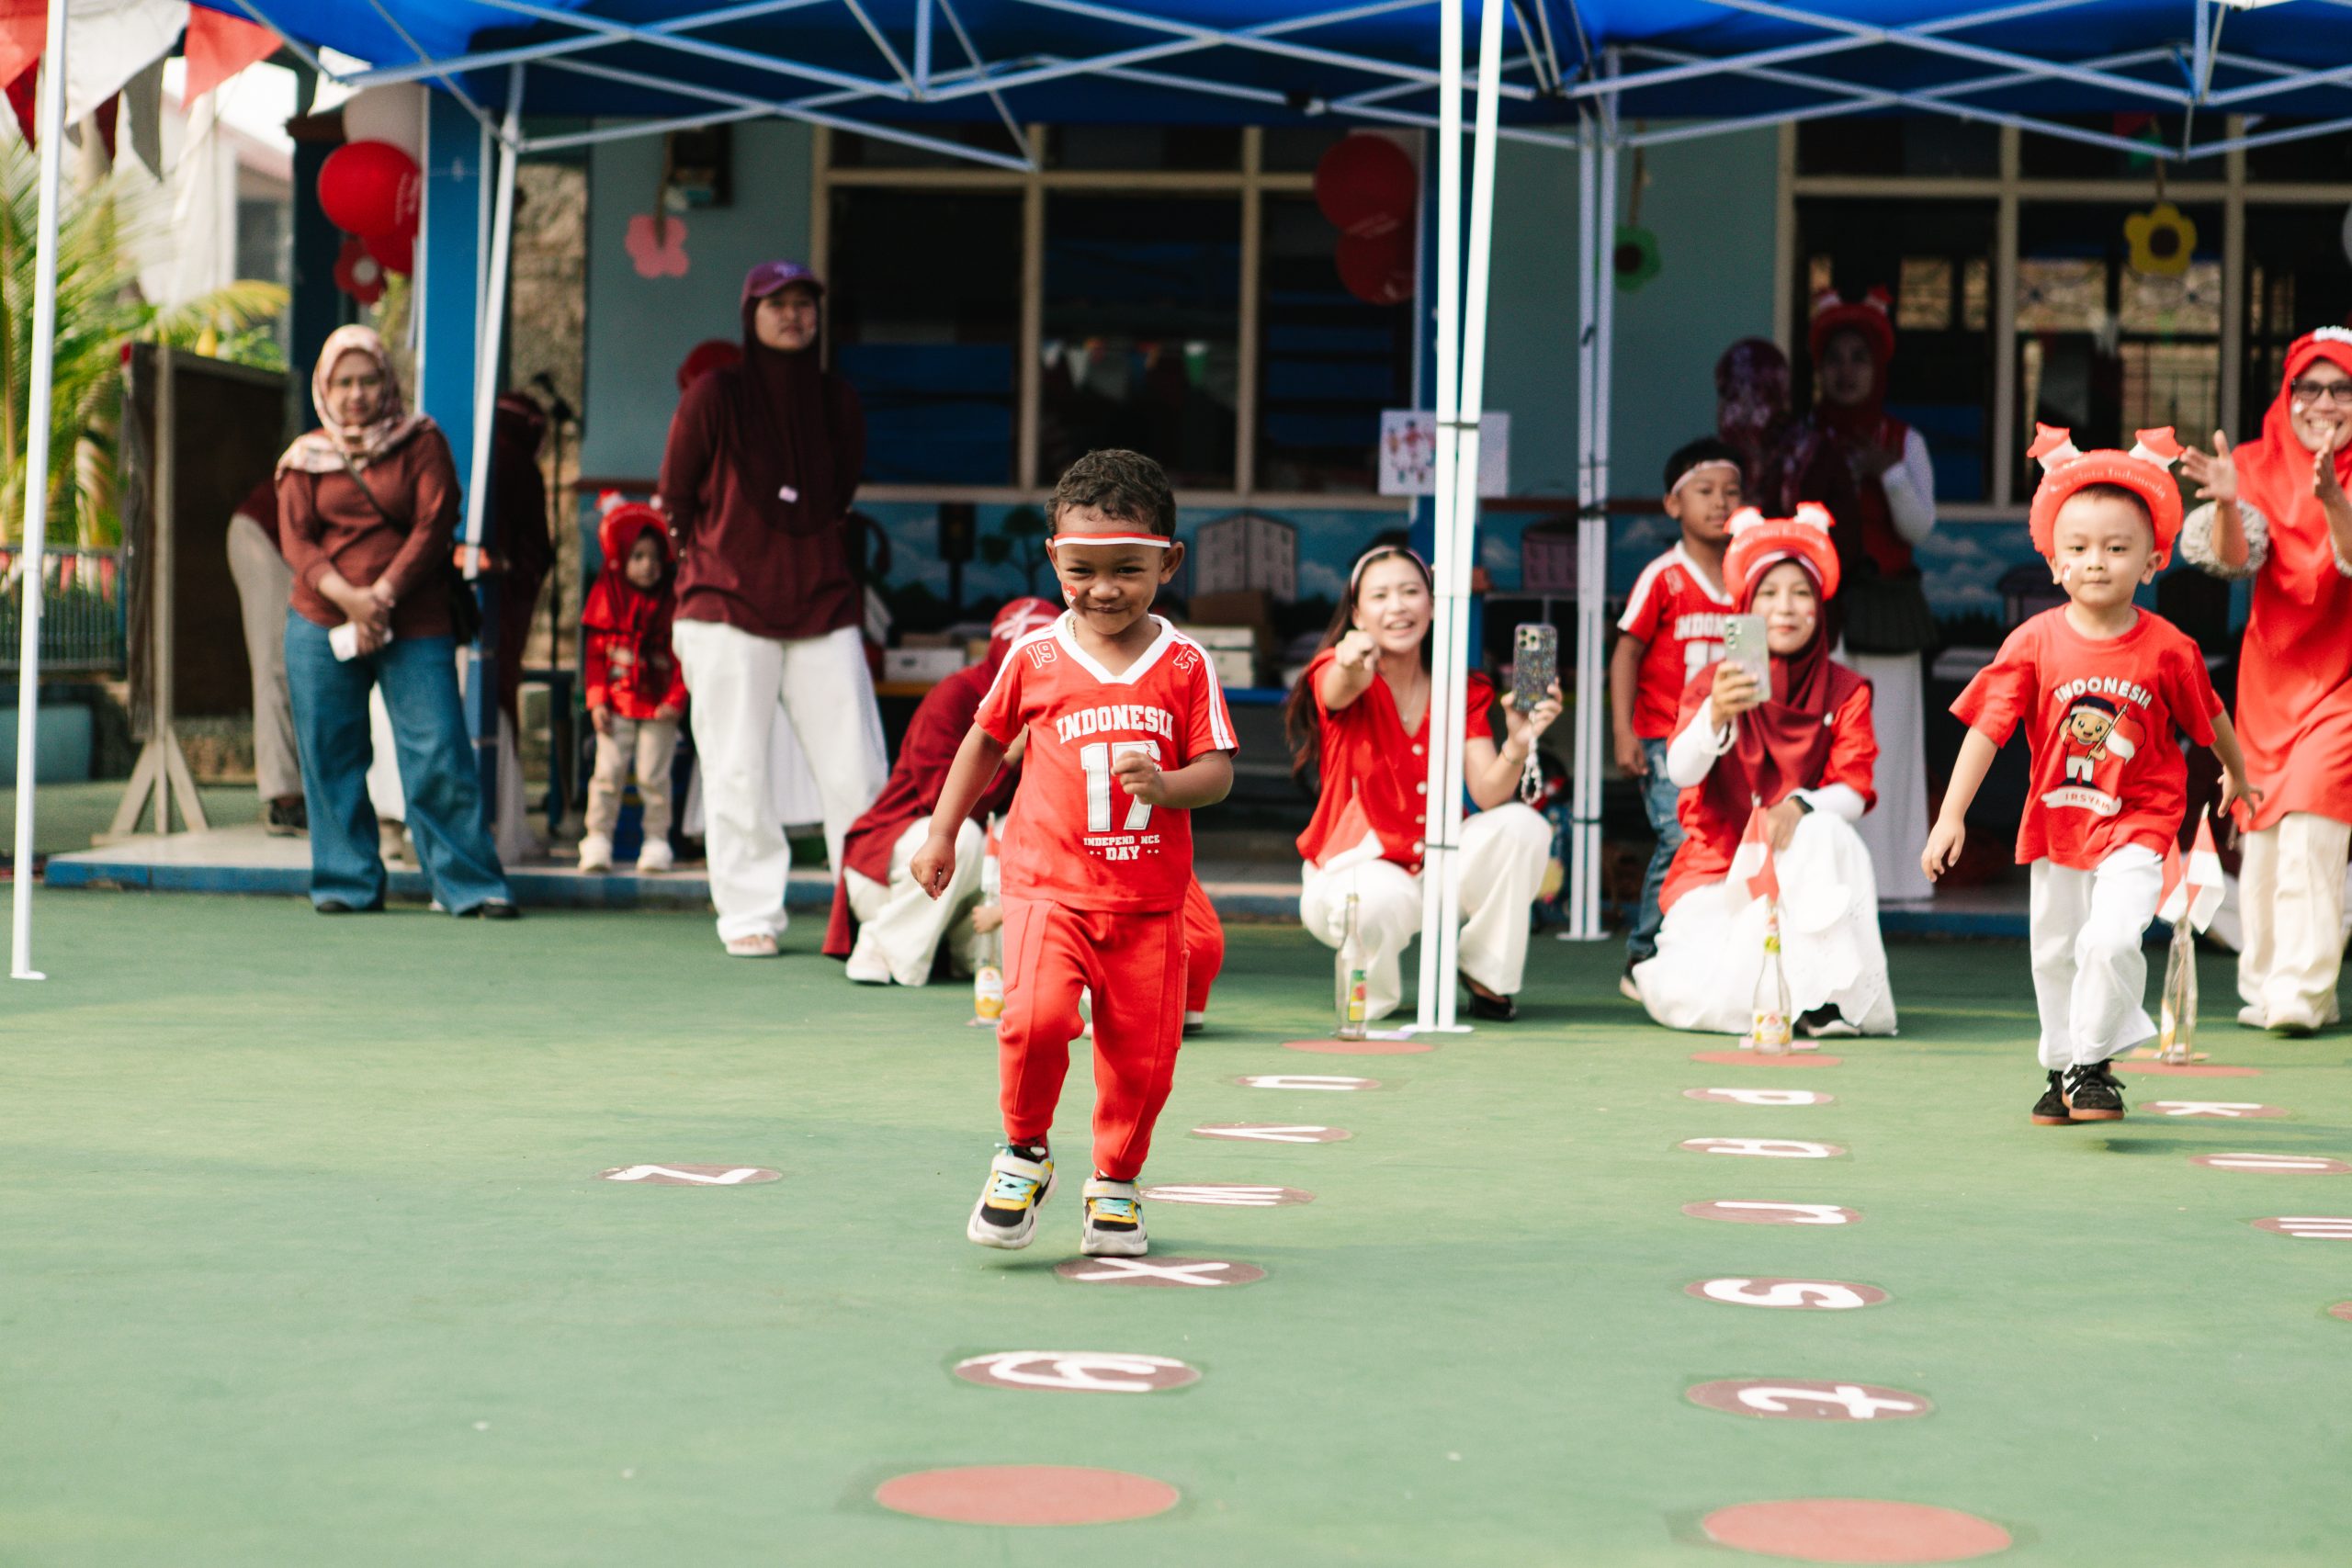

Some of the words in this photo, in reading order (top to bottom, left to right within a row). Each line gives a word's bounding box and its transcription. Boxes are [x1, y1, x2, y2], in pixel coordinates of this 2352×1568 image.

[1674, 613, 1725, 640] INDON
[1026, 640, 1057, 670] 19
[1172, 647, 1199, 675] 45
[2053, 675, 2153, 710] INDONESIA
[1056, 704, 1174, 745] INDONESIA
[1080, 740, 1161, 832] 17
[1105, 845, 1140, 861] DAY
